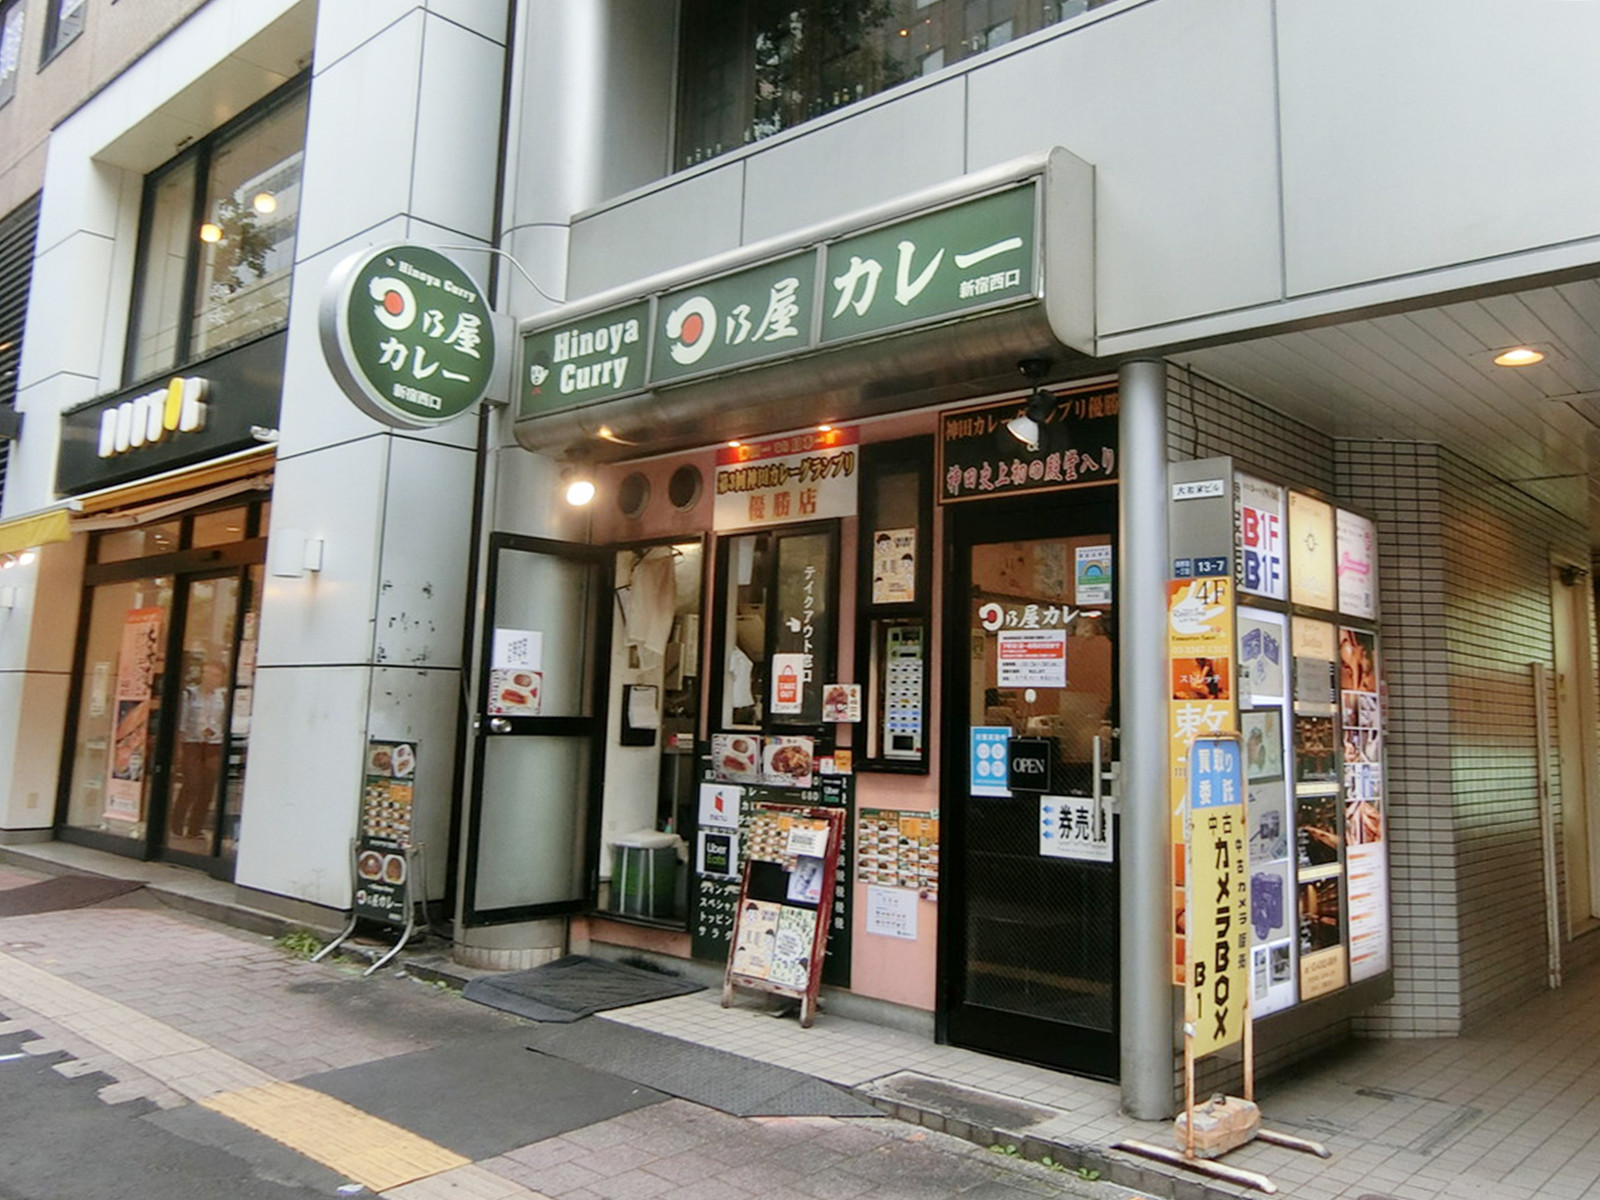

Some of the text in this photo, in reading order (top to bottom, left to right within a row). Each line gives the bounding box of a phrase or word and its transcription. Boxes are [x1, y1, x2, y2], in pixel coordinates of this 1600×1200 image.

[397, 259, 477, 304] Hinoya Curry
[831, 236, 1023, 320] カレー
[958, 268, 1021, 300] 新宿西口
[379, 336, 471, 384] カレー
[553, 318, 640, 364] Hinoya
[559, 356, 629, 395] Curry
[1243, 506, 1279, 552] B1F
[1198, 560, 1225, 572] 13-7
[1244, 549, 1280, 594] B1F
[1196, 579, 1228, 605] 4F
[1013, 758, 1045, 773] OPEN
[706, 843, 728, 855] Uber
